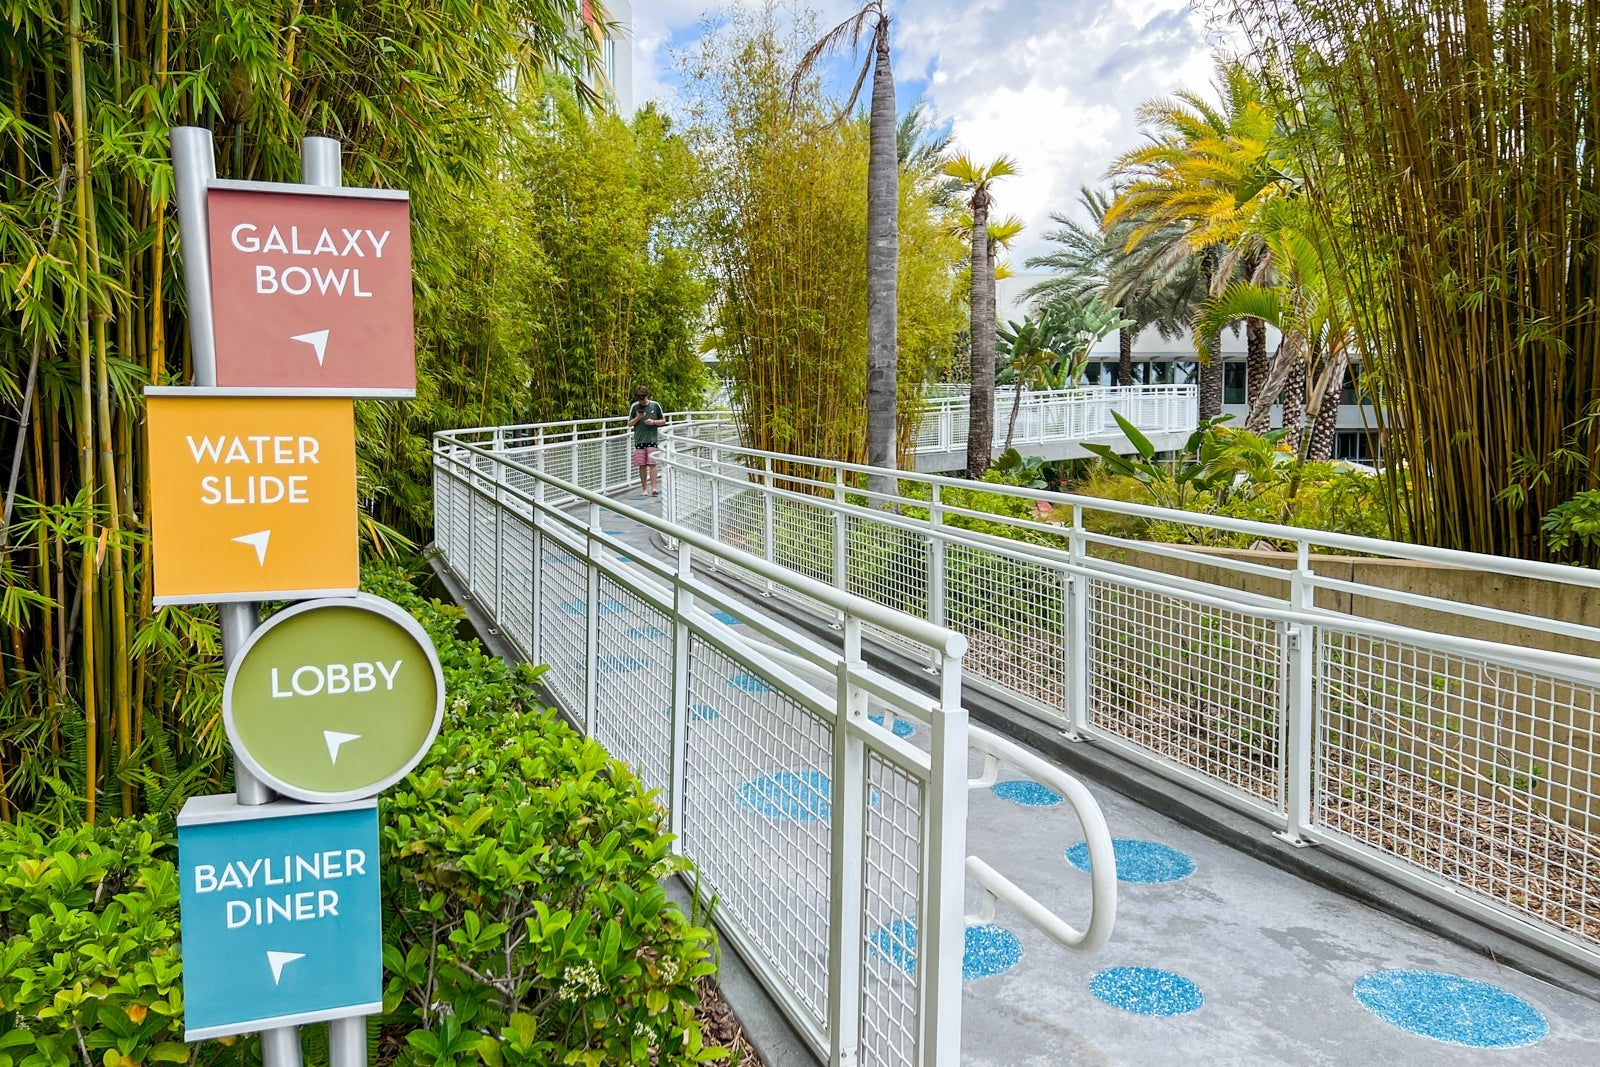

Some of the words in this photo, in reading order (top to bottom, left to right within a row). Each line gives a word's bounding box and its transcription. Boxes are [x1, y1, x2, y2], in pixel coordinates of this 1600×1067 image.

[230, 222, 391, 259] GALAXY
[254, 264, 373, 298] BOWL
[186, 435, 320, 465] WATER
[200, 475, 310, 505] SLIDE
[270, 660, 403, 700] LOBBY
[194, 849, 367, 893] BAYLINER
[226, 889, 340, 929] DINER
